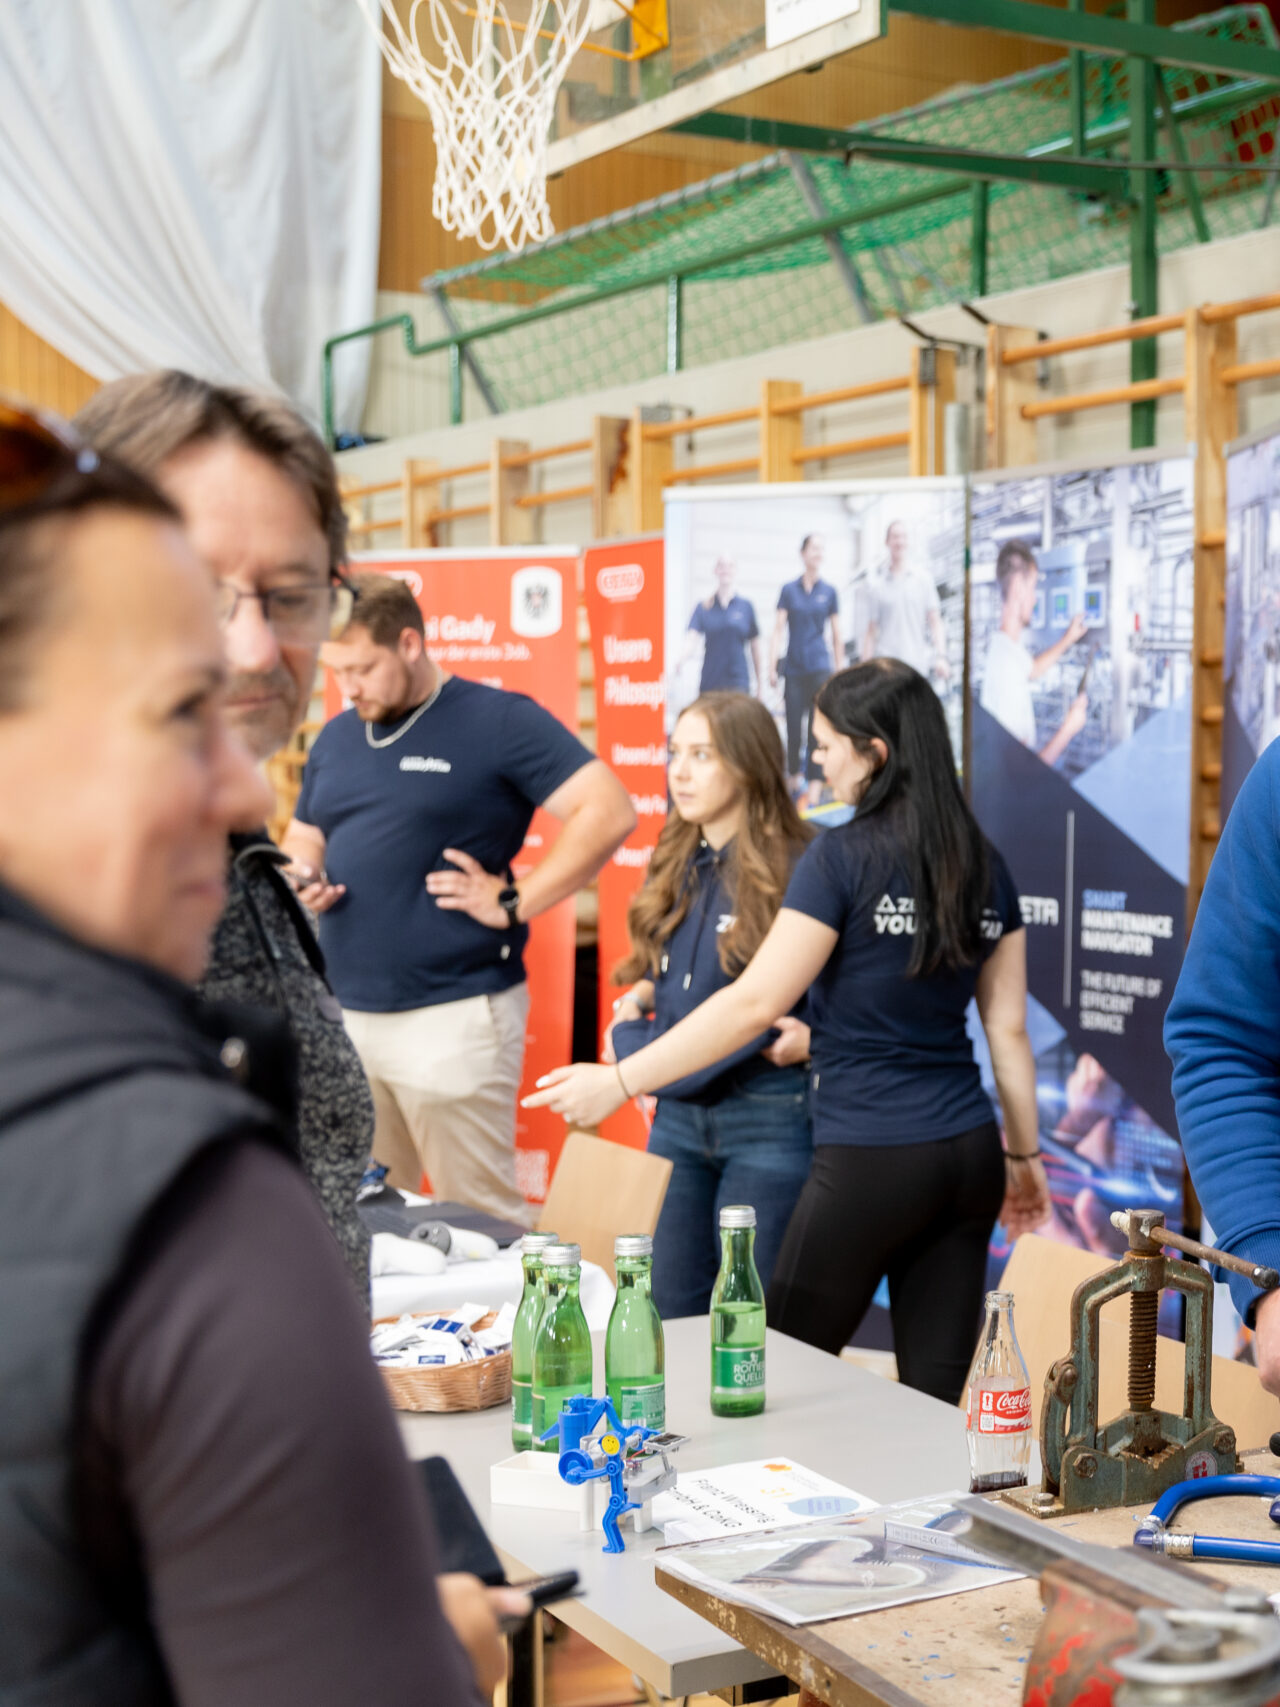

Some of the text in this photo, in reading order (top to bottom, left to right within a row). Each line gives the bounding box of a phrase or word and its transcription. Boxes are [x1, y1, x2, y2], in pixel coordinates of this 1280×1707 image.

[1082, 888, 1127, 910] SMART
[1081, 908, 1173, 939] MAINTENANCE
[1080, 929, 1153, 957] NAVIGATOR
[1081, 968, 1163, 998] THE FUTURE OF
[1080, 989, 1134, 1014] EFFICIENT
[1080, 1009, 1125, 1035] SERVICE
